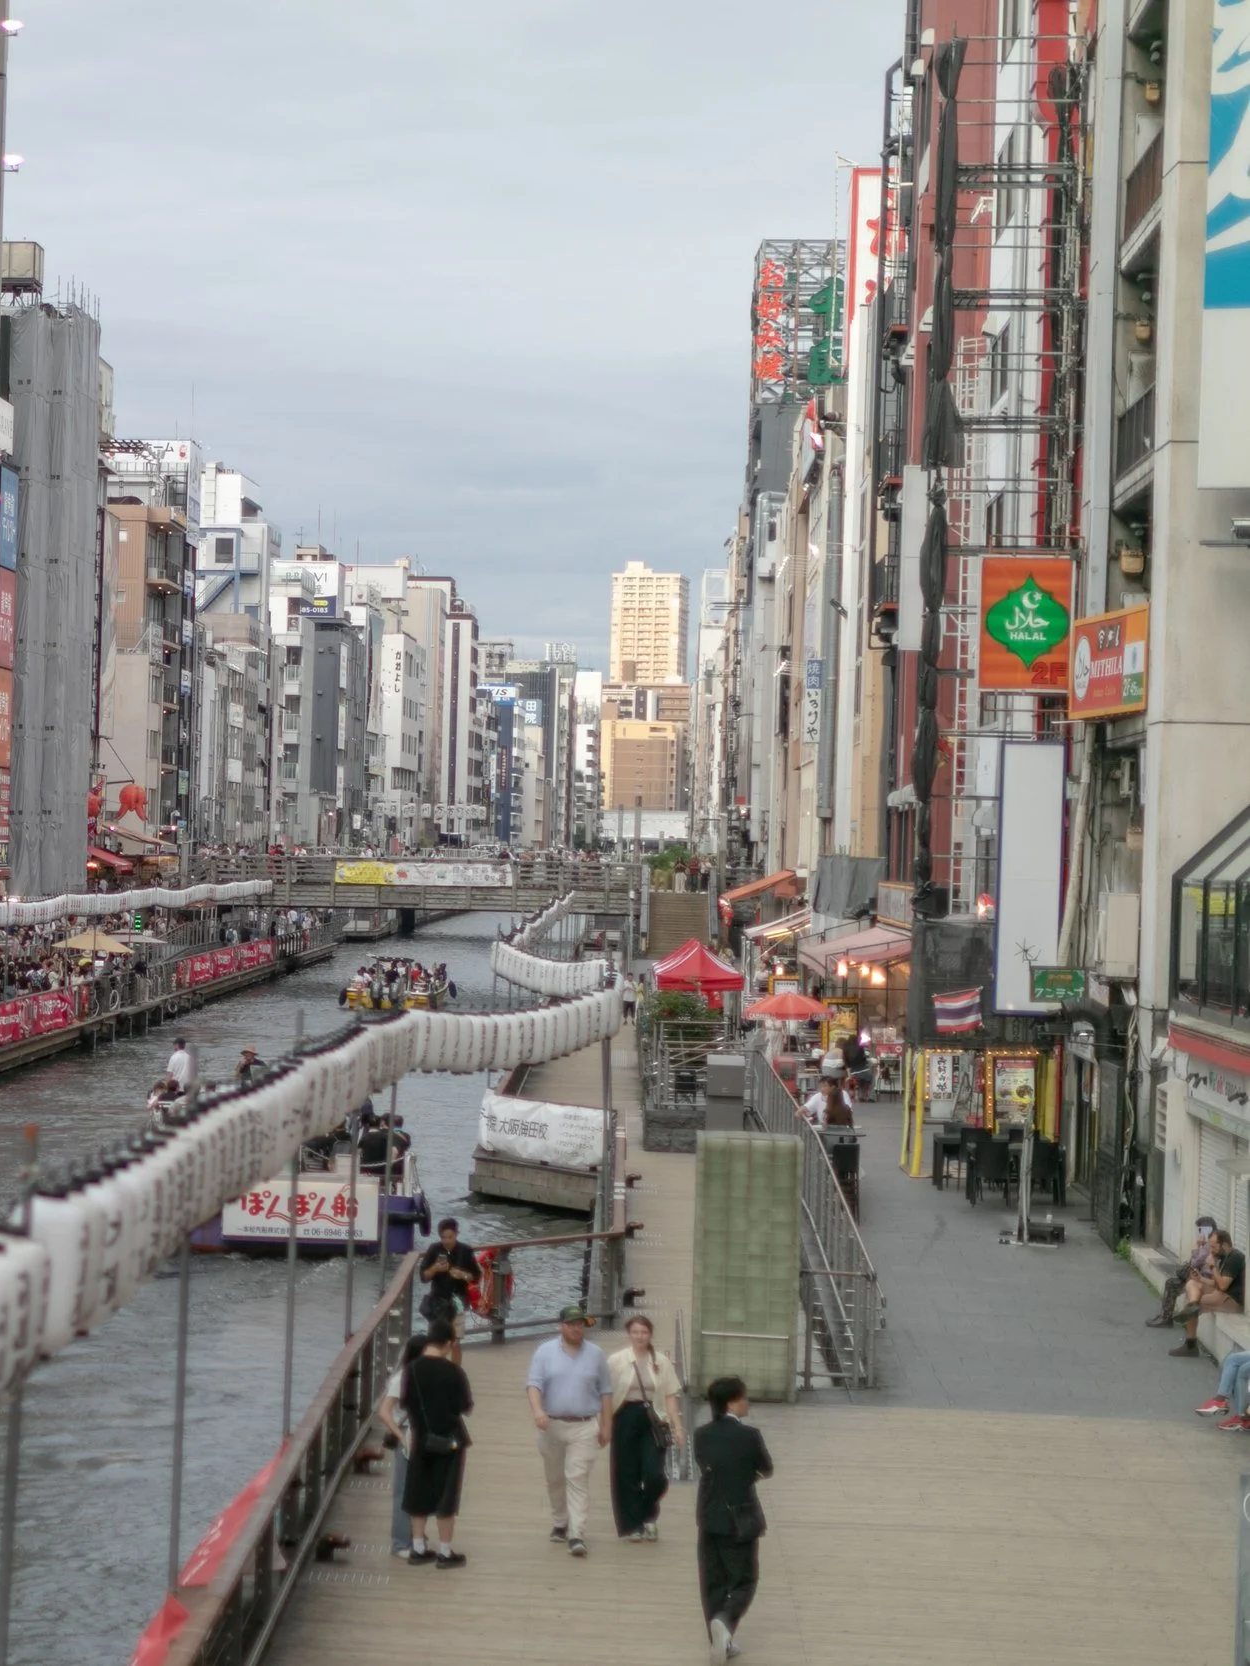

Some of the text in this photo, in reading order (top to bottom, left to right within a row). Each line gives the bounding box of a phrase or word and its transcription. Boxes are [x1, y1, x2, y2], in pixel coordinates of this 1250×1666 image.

[1005, 605, 1050, 631] حلال
[1010, 631, 1047, 641] HALAL
[807, 661, 821, 688] 焼肉
[1031, 661, 1067, 685] 2F
[1090, 656, 1123, 679] MITHILA
[806, 691, 819, 740] いろりや
[311, 1228, 363, 1238] 06-6946-863
